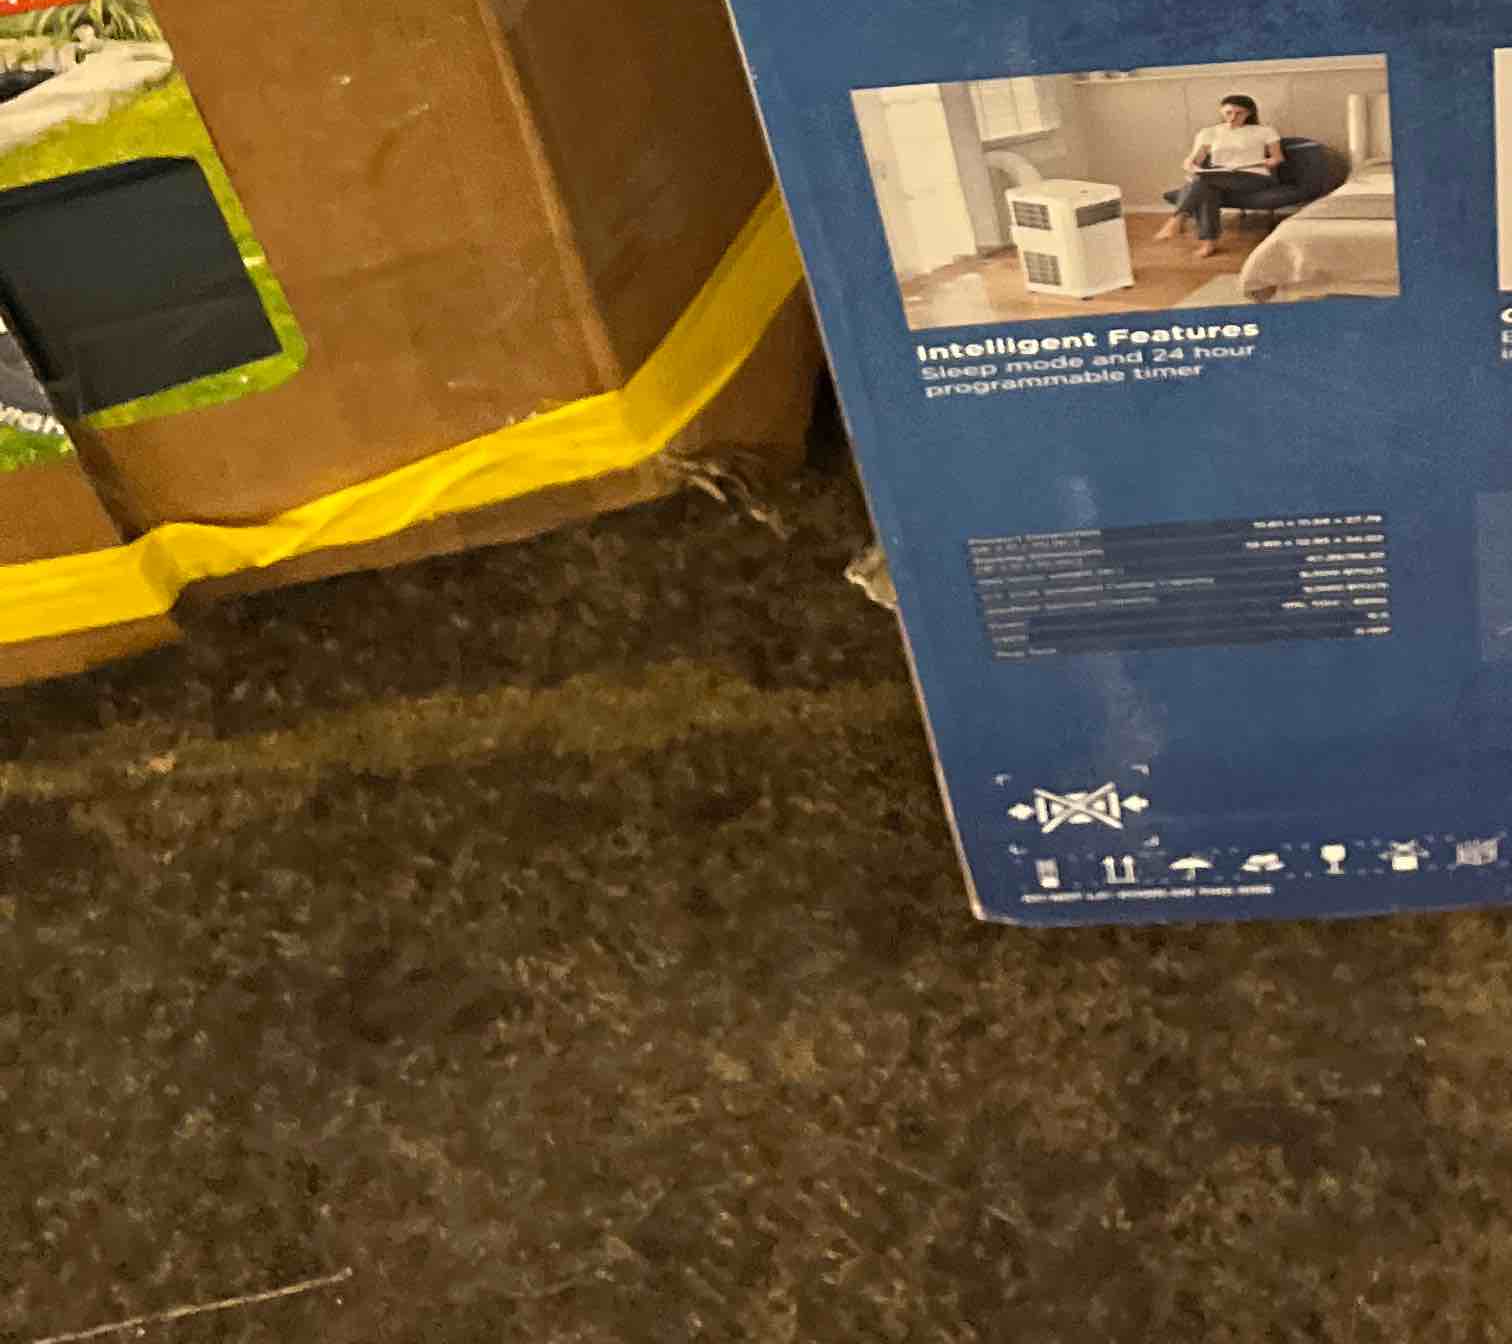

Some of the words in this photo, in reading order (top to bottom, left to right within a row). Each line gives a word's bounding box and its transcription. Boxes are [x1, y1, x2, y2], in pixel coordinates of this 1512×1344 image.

[916, 328, 1096, 363] Intelligent
[1108, 320, 1261, 348] Features
[920, 359, 999, 382] Sleep
[1005, 354, 1085, 374] mode
[1091, 349, 1144, 367] and
[1150, 346, 1187, 365] 24
[1193, 341, 1257, 361] hour
[924, 371, 1126, 399] programmable
[1131, 362, 1205, 384] timer
